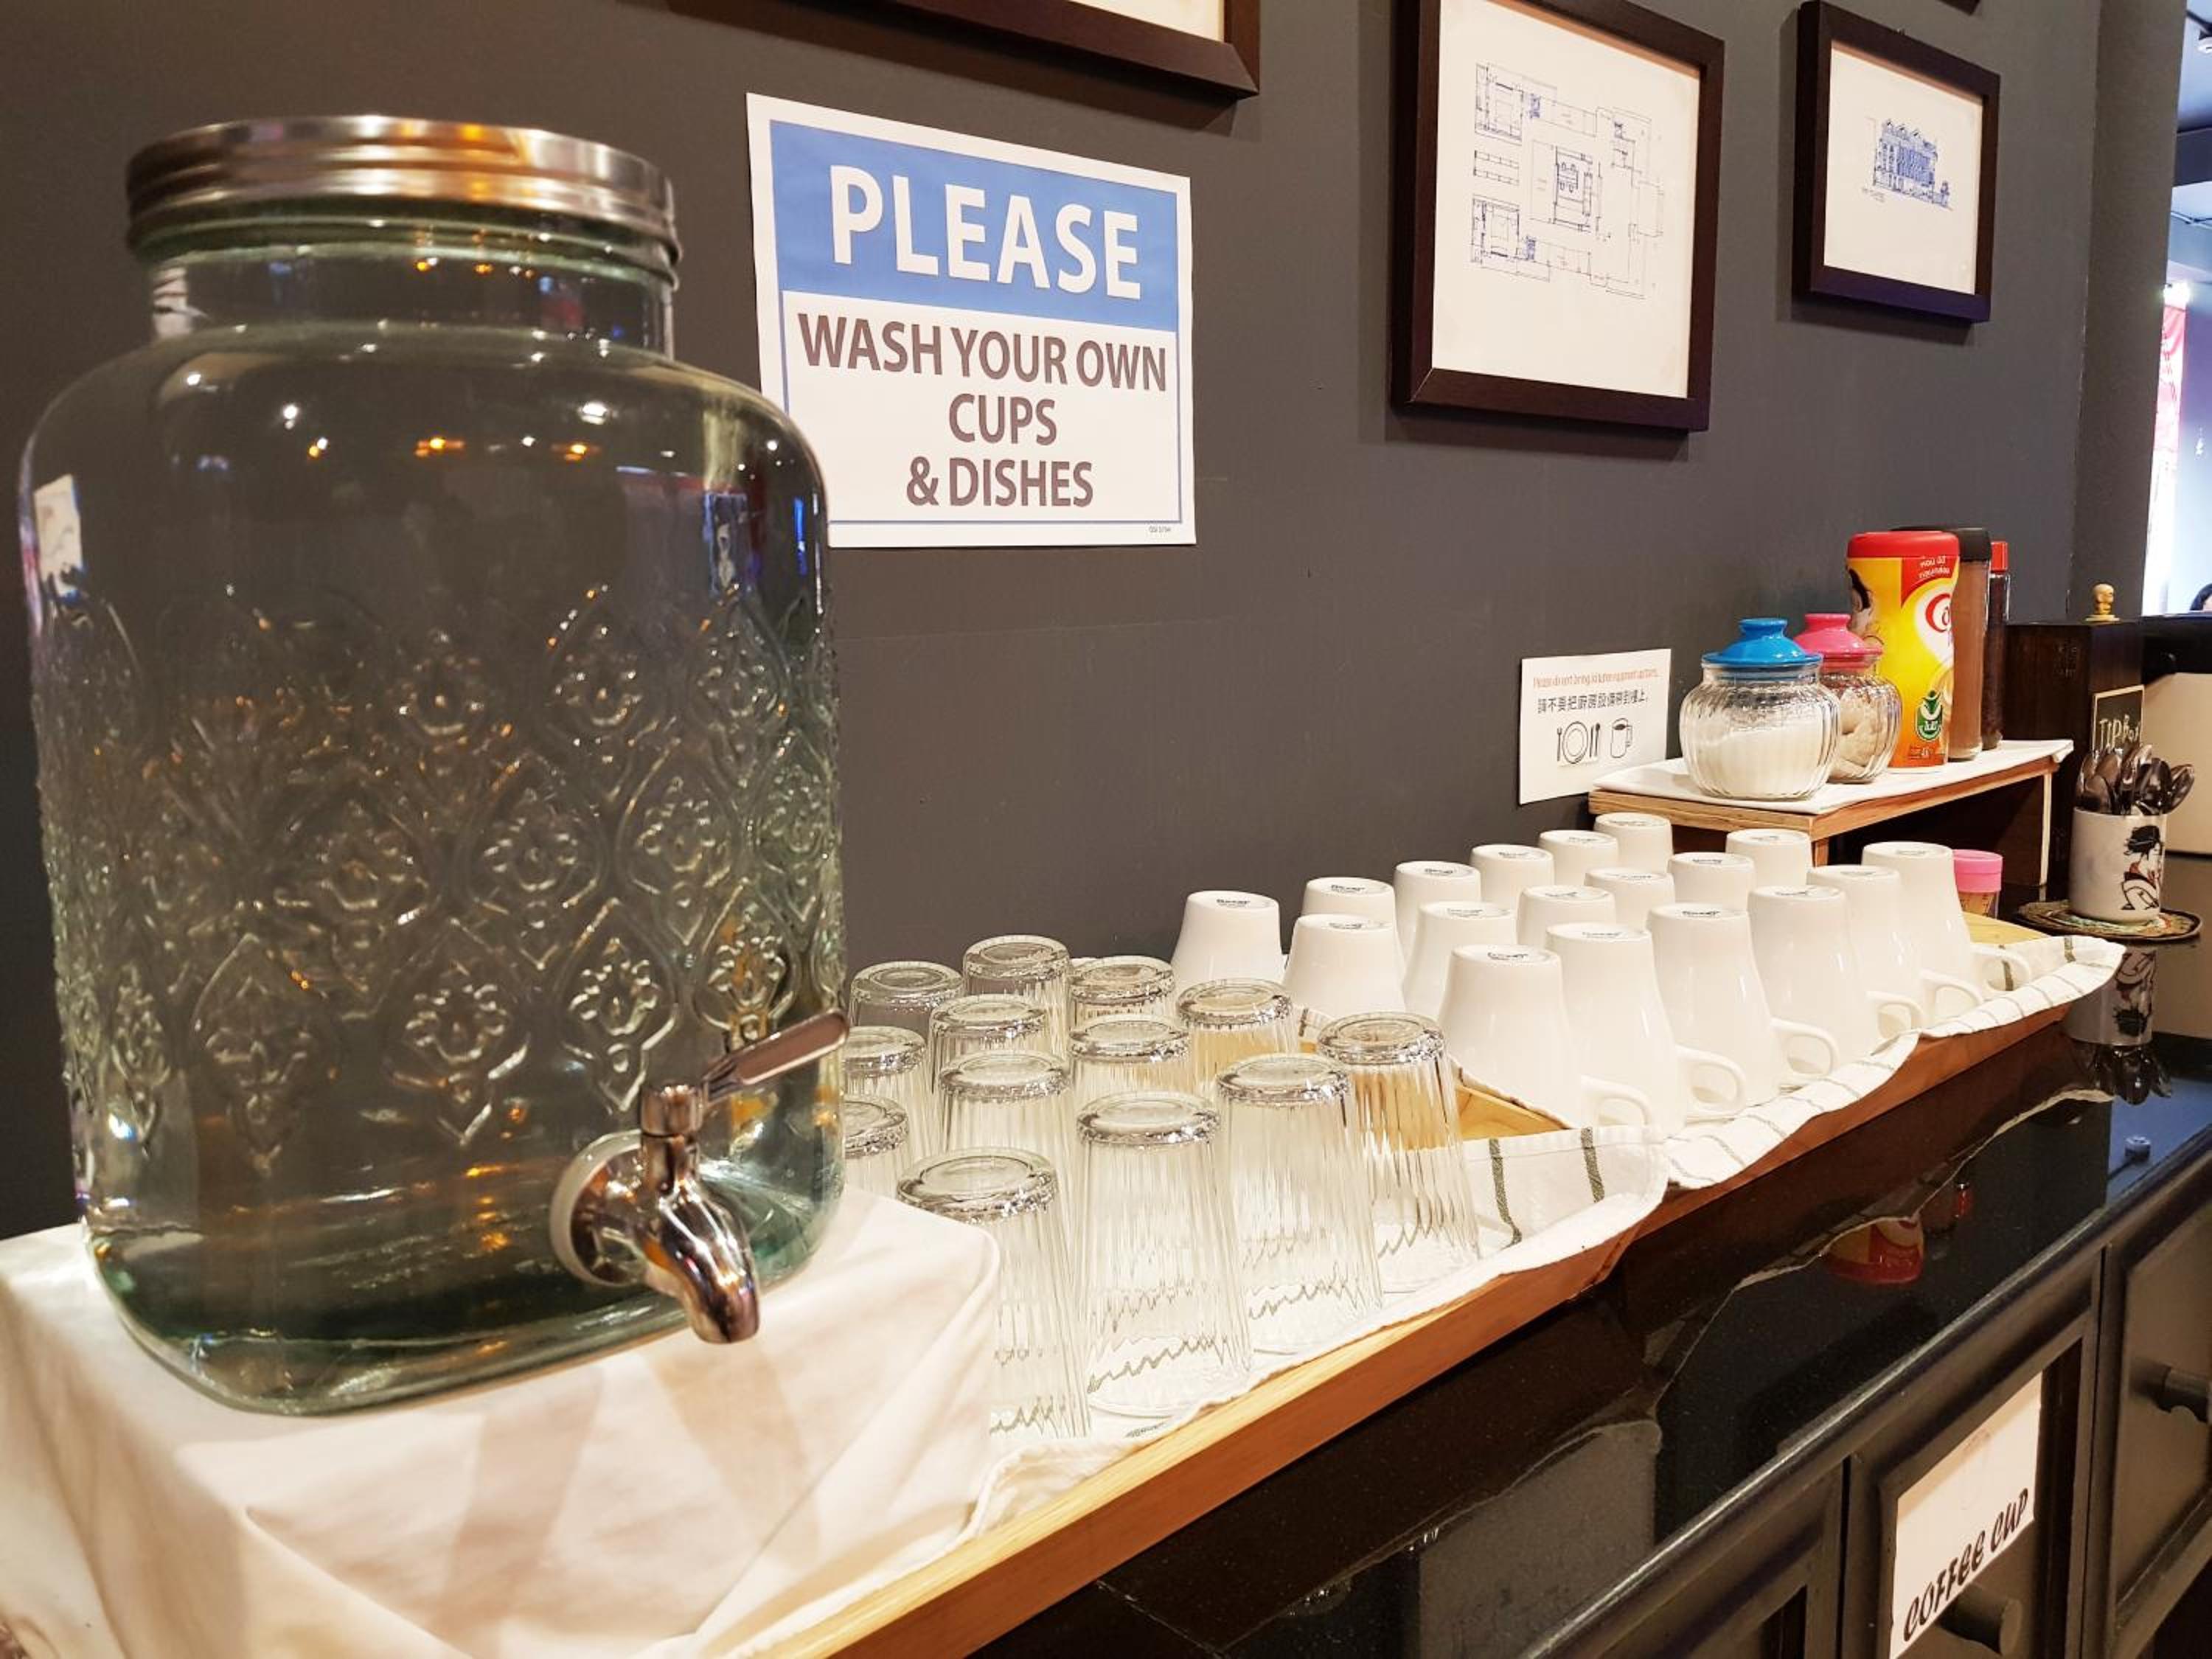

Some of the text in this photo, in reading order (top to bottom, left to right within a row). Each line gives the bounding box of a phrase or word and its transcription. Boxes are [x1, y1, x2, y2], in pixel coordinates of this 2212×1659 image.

[830, 164, 1141, 300] PLEASE
[797, 313, 1167, 392] WASH YOUR OWN
[948, 393, 1057, 445] CUPS
[906, 456, 1093, 508] & DISHES
[1903, 1487, 2028, 1642] COFFEE CUP
